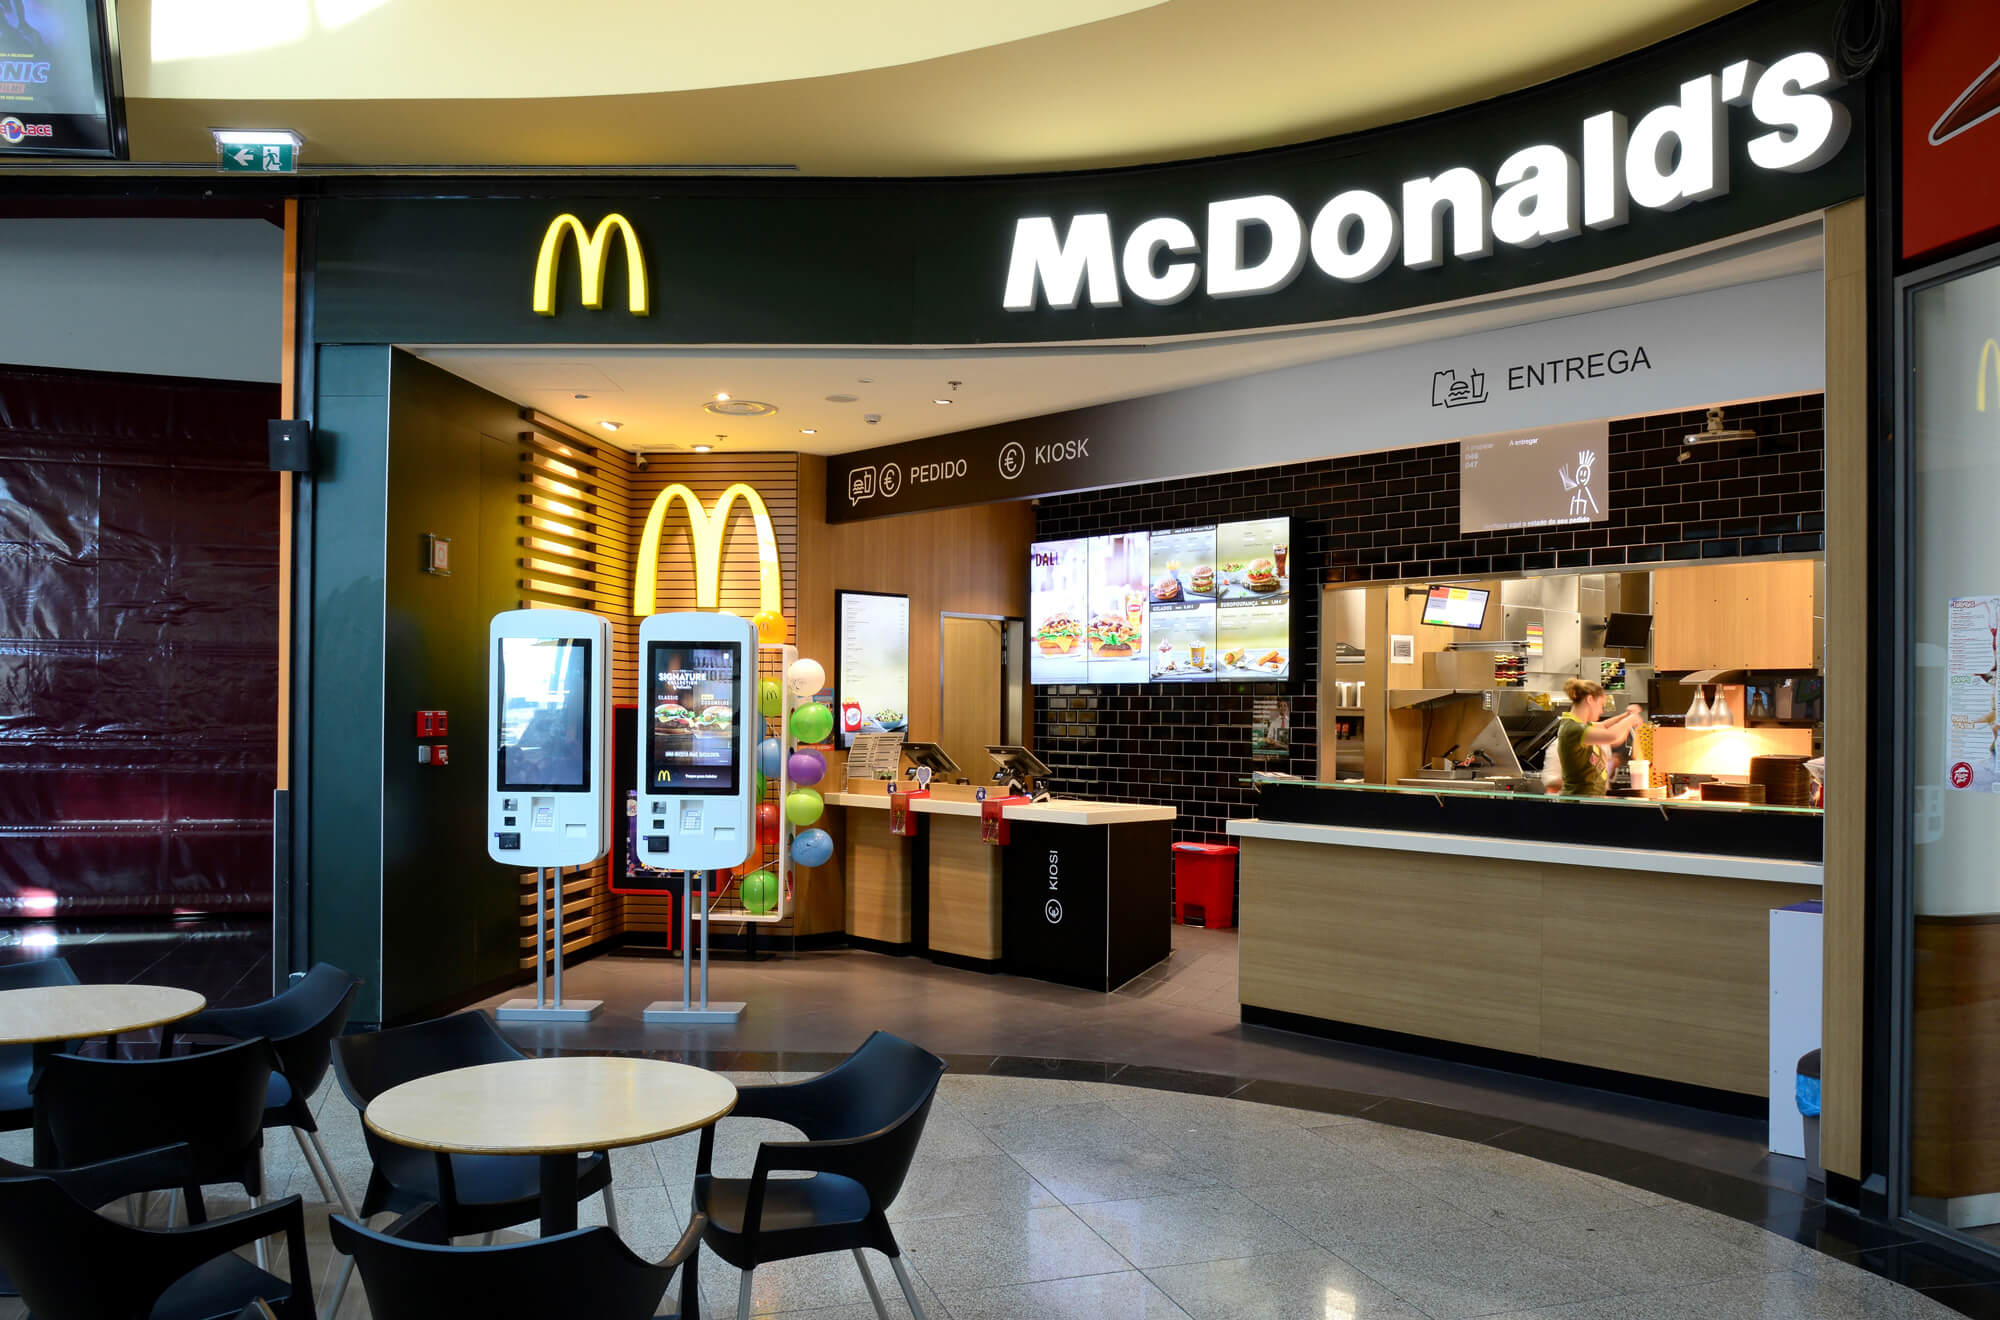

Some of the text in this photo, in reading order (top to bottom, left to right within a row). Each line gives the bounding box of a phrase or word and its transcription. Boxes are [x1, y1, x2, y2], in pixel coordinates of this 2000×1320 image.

[0, 61, 50, 83] NIC
[1003, 51, 1847, 311] McDonald's
[532, 213, 649, 316] M
[1508, 346, 1652, 391] ENTREGA
[1034, 438, 1090, 465] KIOSK
[1515, 438, 1539, 447] entregar
[910, 459, 968, 484] PEDIDO
[658, 672, 707, 681] SIGNATURE
